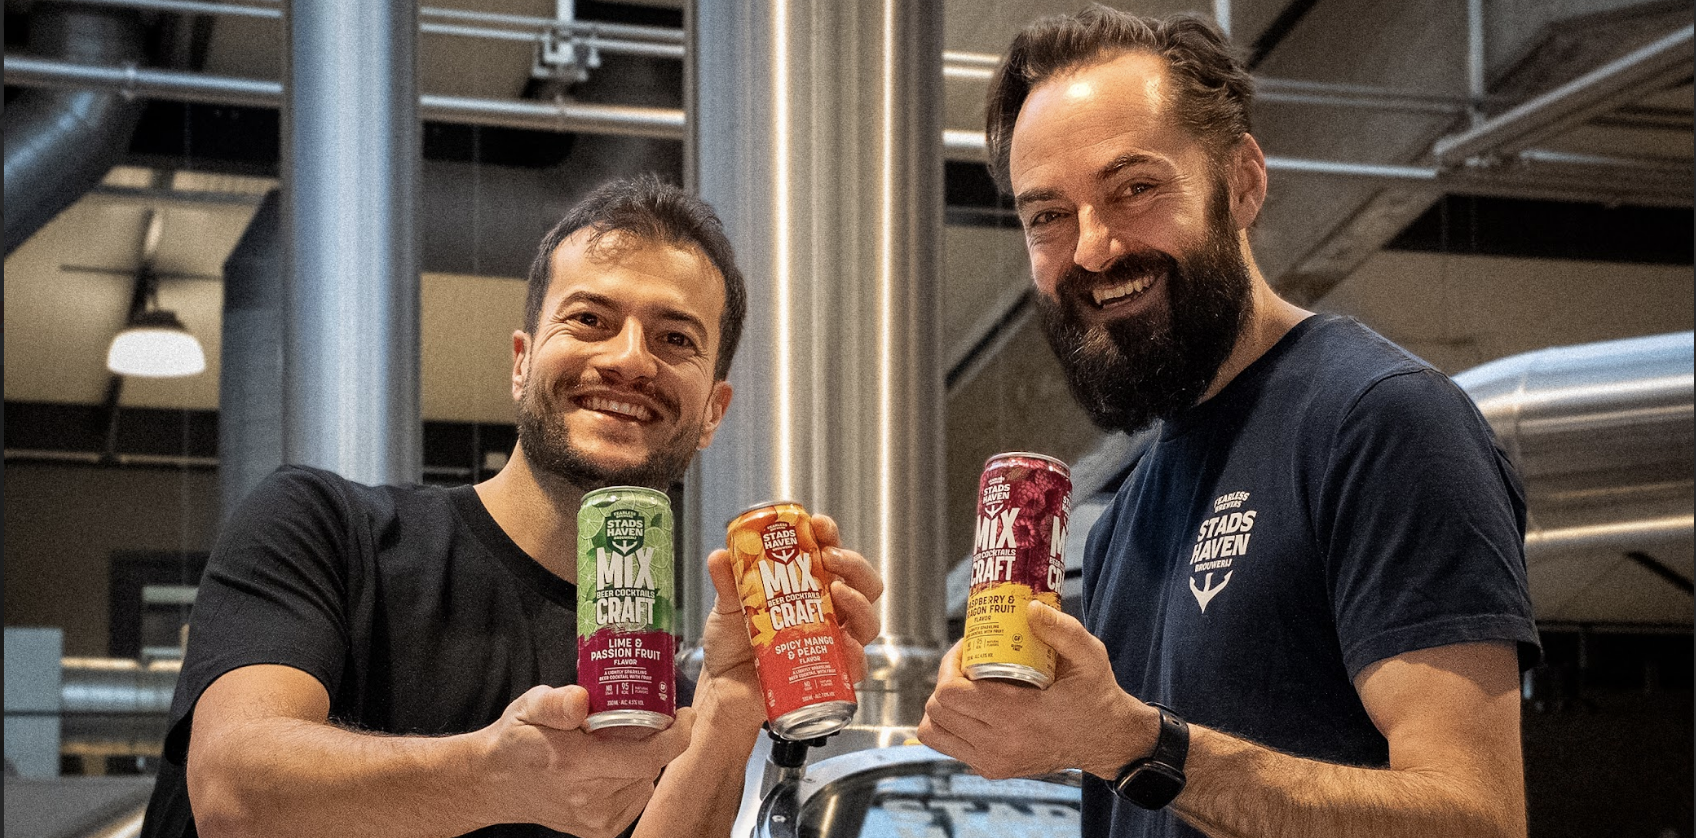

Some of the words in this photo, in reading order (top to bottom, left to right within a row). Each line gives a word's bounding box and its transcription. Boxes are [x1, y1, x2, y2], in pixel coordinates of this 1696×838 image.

[984, 484, 1010, 496] STADS
[983, 492, 1010, 504] HAVEN
[1214, 491, 1250, 508] FEARLESS
[607, 519, 643, 528] STADS
[1197, 510, 1257, 542] STADS
[607, 528, 643, 537] HAVEN
[763, 529, 796, 542] STADS
[974, 508, 1020, 555] MIX
[764, 537, 798, 550] HAVEN
[1189, 533, 1251, 565] HAVEN
[981, 549, 1016, 559] COCKTAILS
[596, 547, 654, 590] MIX
[971, 556, 1016, 587] CRAFT
[1194, 559, 1233, 573] BROUWERIJ
[758, 553, 819, 600] MIX
[597, 590, 614, 598] BEER
[615, 589, 655, 598] COCKTAILS
[767, 597, 785, 607] BEER
[785, 592, 820, 603] COCKTAILS
[1007, 595, 1015, 604] &
[596, 597, 655, 625] CRAFT
[769, 600, 825, 630] CRAFT
[989, 605, 1016, 614] FRUIT
[608, 638, 632, 648] LIME
[635, 638, 642, 648] &
[775, 640, 801, 655] SPICY
[803, 636, 834, 648] MANGO
[591, 648, 632, 661] PASSION
[635, 648, 661, 661] FRUIT
[788, 651, 795, 660] &
[797, 645, 828, 657] PEACH
[800, 656, 821, 664] FLAVOR
